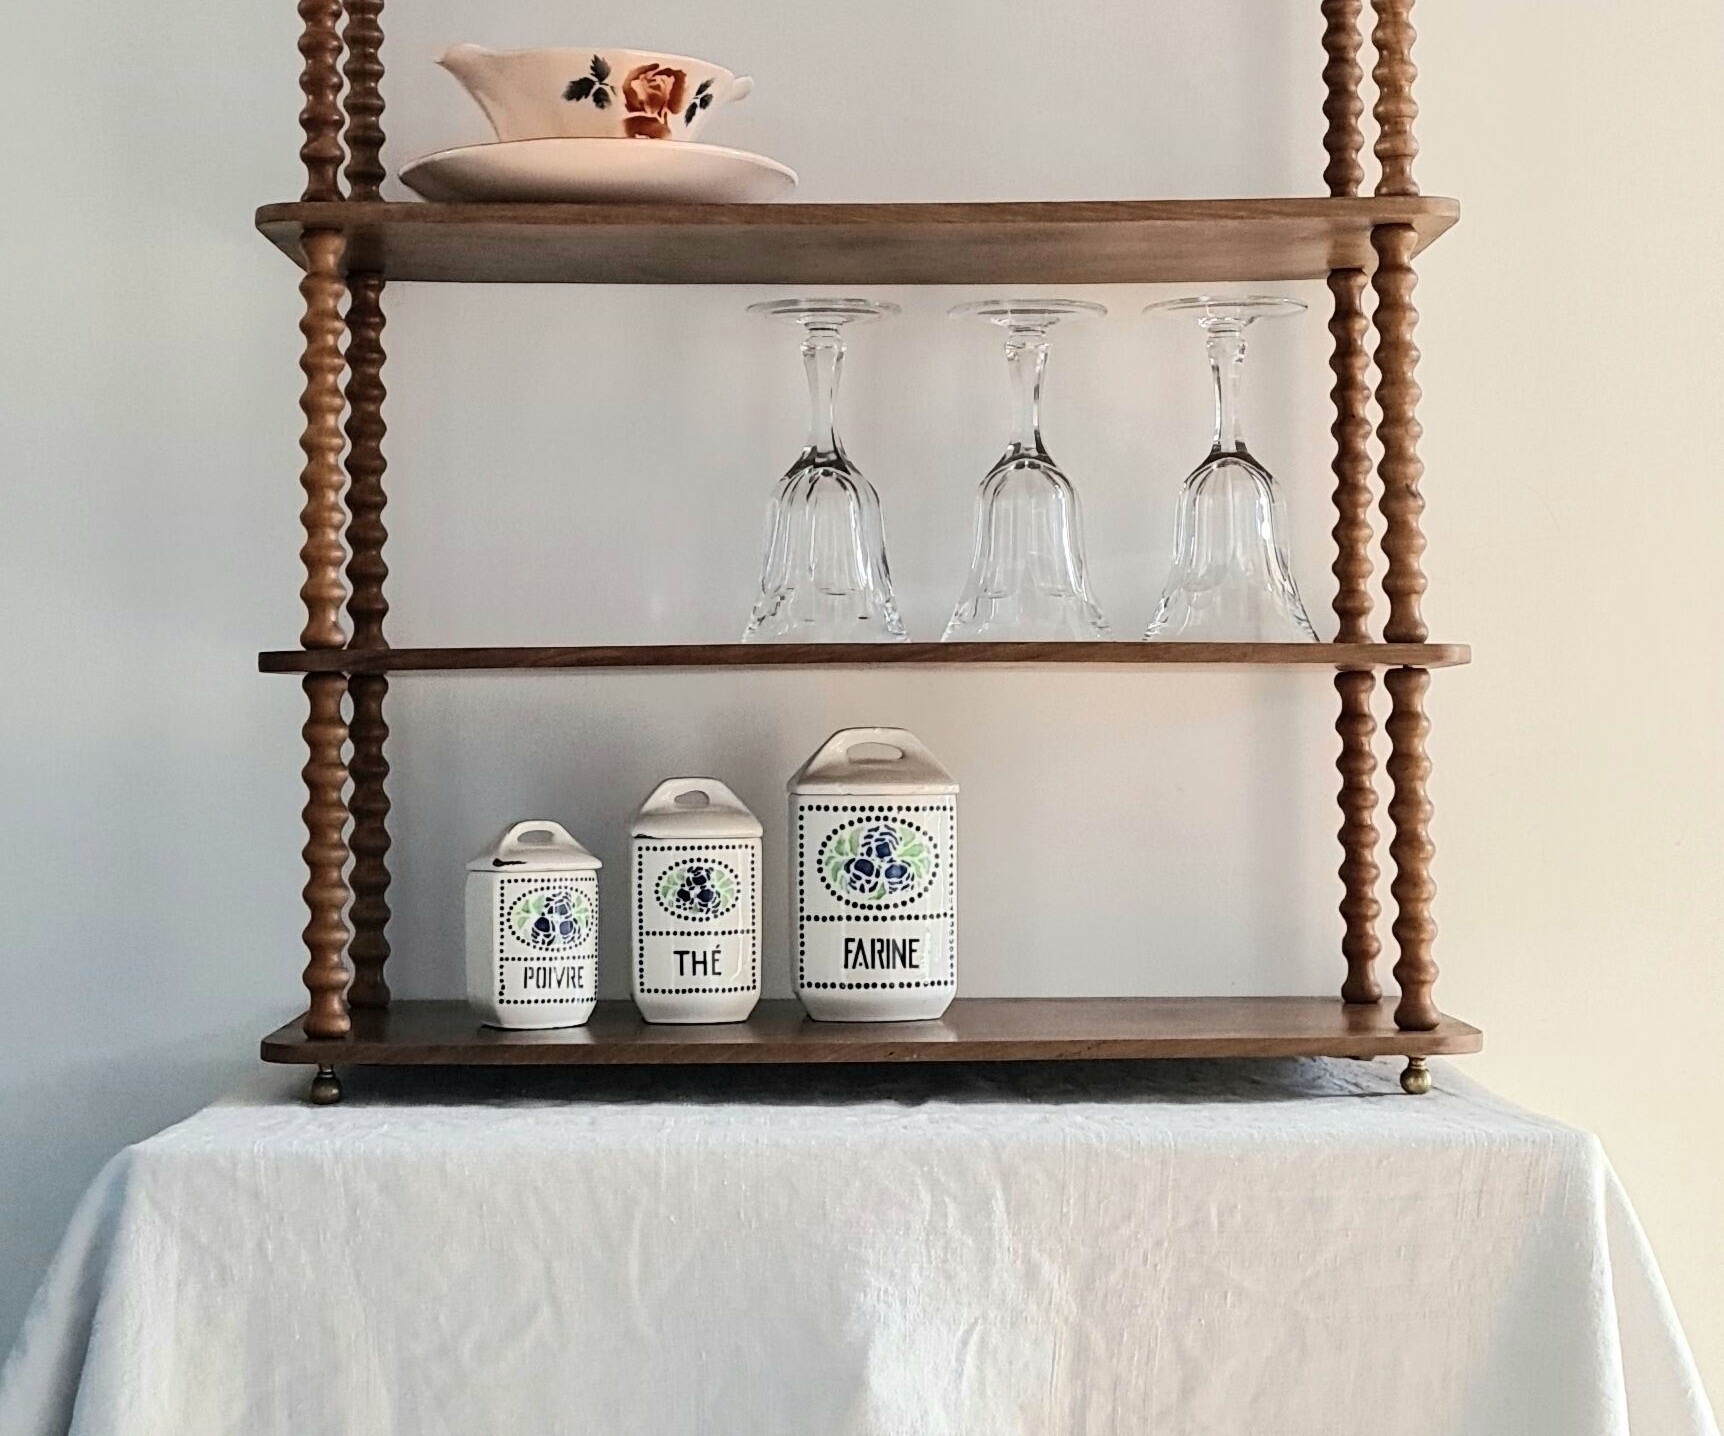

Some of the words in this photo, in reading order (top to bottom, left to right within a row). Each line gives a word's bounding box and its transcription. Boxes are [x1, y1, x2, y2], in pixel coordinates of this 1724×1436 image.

[673, 944, 722, 977] THÉ
[843, 937, 920, 970] FARINE
[523, 965, 584, 991] POIVRE
